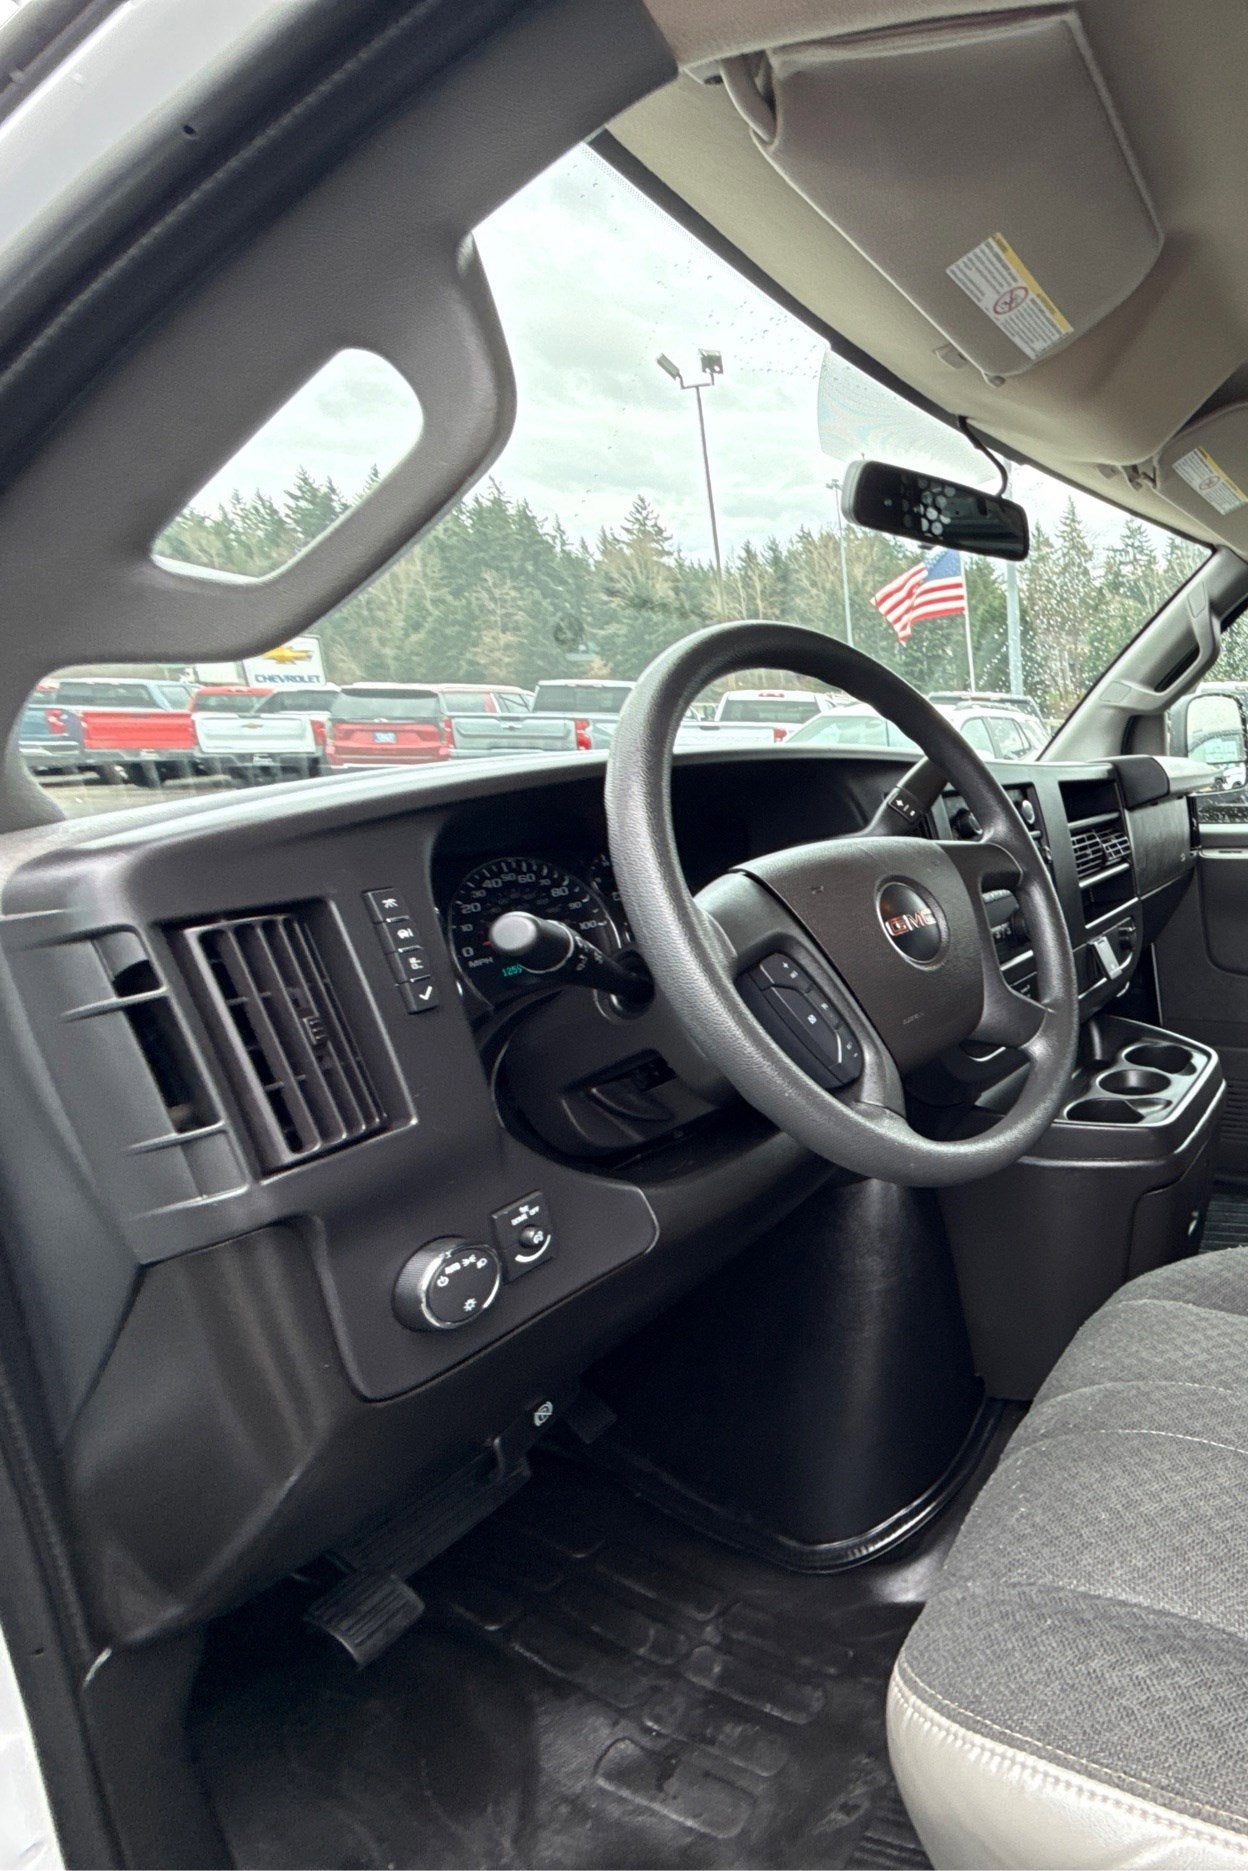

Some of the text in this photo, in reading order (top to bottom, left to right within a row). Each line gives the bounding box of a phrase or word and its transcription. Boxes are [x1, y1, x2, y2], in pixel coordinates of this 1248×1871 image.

[254, 673, 320, 684] CHEVROLET
[482, 879, 502, 889] 40
[517, 874, 537, 884] 60
[472, 890, 486, 898] 30
[551, 886, 569, 897] 80
[461, 903, 482, 914] 20
[568, 901, 583, 910] 90
[461, 924, 473, 932] 10
[579, 920, 597, 931] 100
[885, 908, 937, 937] GMC
[462, 946, 474, 958] 0
[468, 957, 494, 968] MPH
